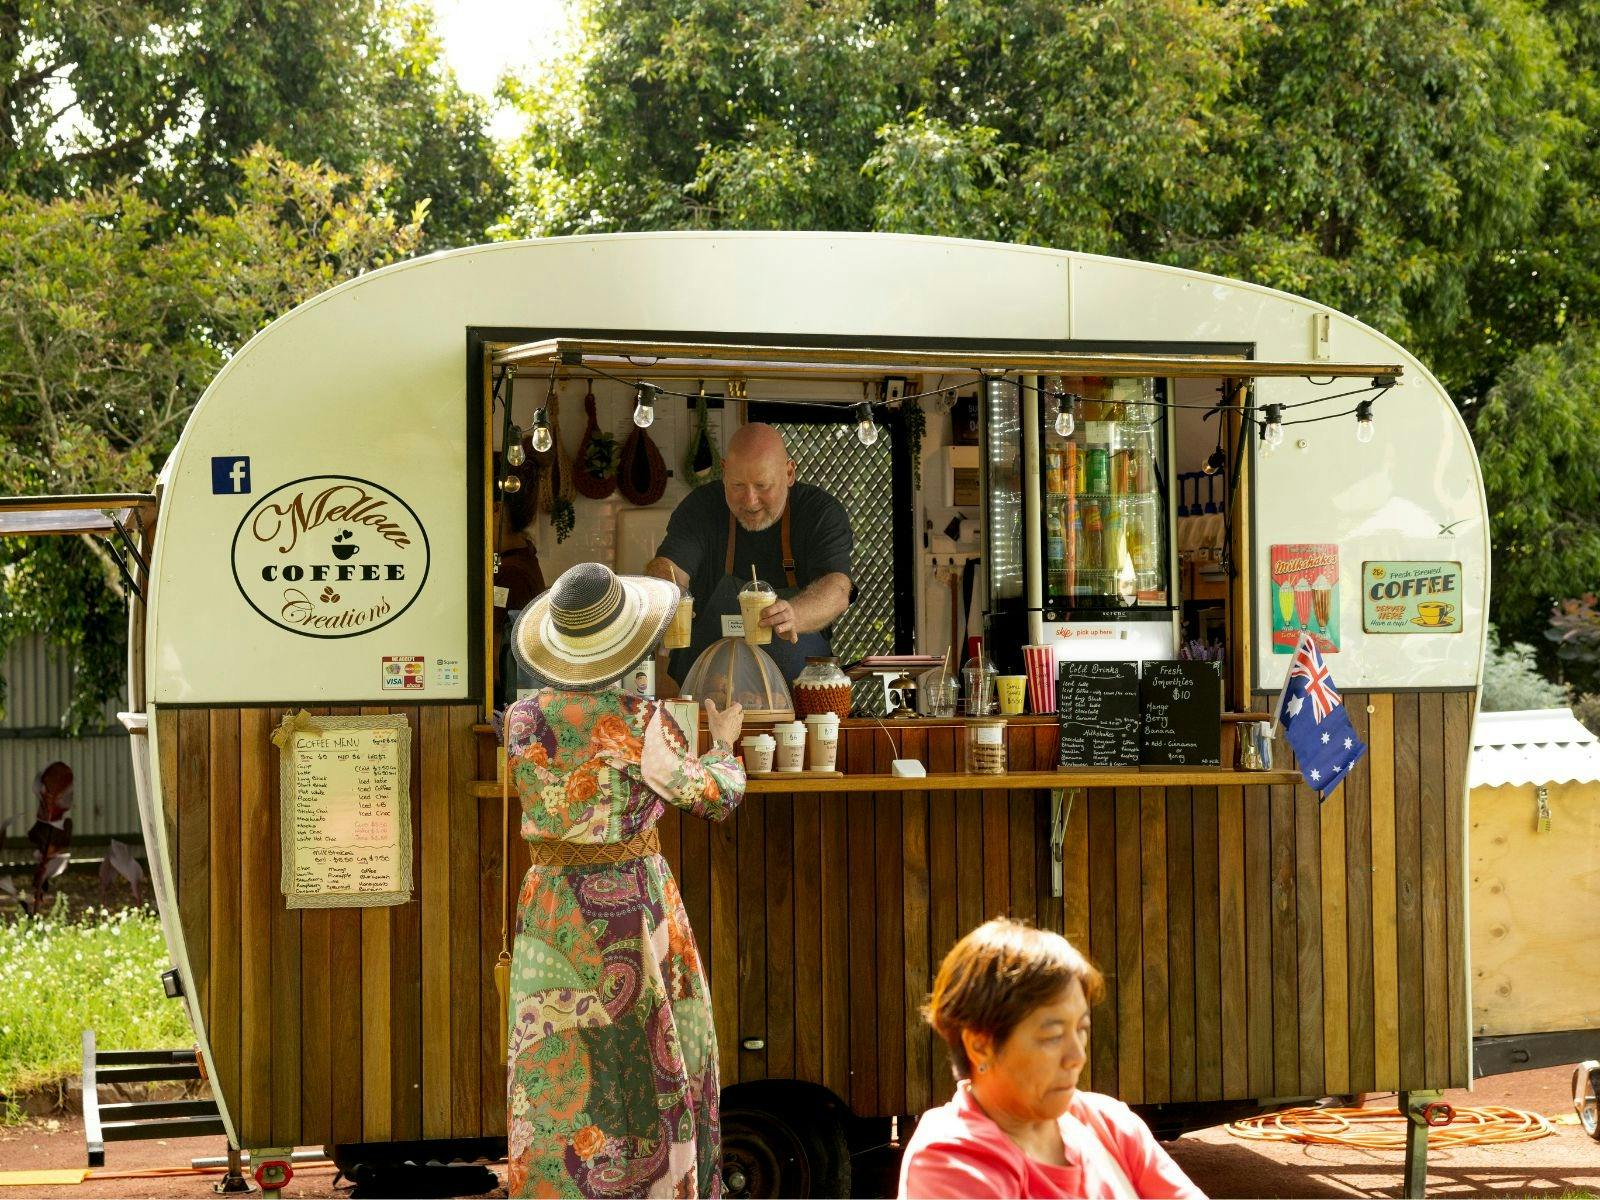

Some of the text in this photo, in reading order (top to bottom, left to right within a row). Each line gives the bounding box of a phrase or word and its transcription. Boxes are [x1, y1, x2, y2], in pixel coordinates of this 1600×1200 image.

[253, 485, 412, 554] Mellow
[262, 564, 405, 582] COFFEE
[1390, 571, 1412, 579] Fresh
[1412, 566, 1442, 577] Brewed
[1370, 574, 1456, 601] COFFEE
[281, 588, 391, 629] Creations
[1378, 612, 1406, 620] HERE
[1070, 664, 1119, 674] Cold Drinks
[1160, 665, 1182, 674] Fresh
[1152, 677, 1194, 688] Smoothies
[1172, 688, 1190, 700] $10
[1146, 702, 1169, 715] Mango
[1146, 714, 1168, 728] Berry
[1144, 726, 1175, 734] Banana
[297, 738, 360, 748] COFFEE MENU
